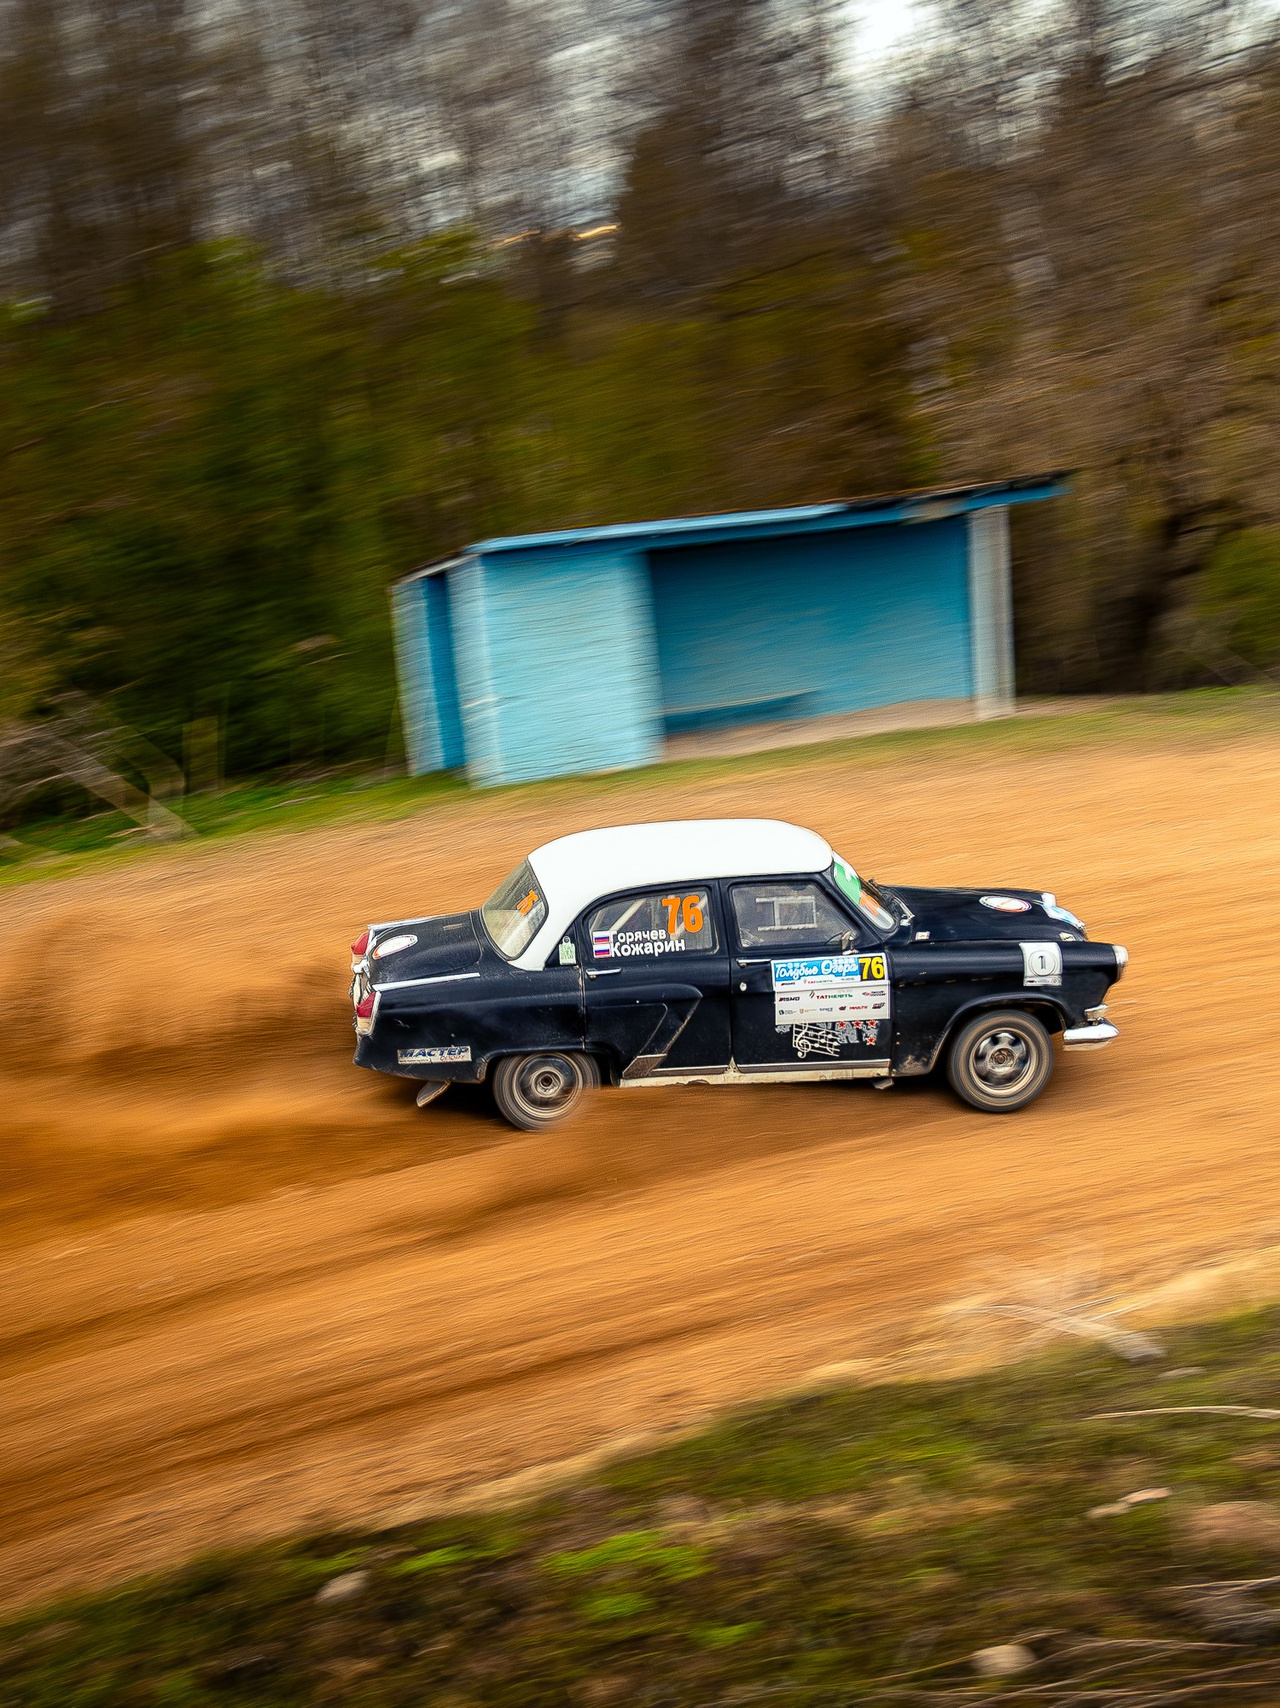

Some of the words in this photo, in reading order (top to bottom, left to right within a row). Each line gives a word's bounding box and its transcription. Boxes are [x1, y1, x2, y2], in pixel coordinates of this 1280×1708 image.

[661, 895, 704, 935] 76
[610, 928, 667, 944] Горячев
[610, 938, 686, 958] Кожарин
[858, 956, 885, 980] 76
